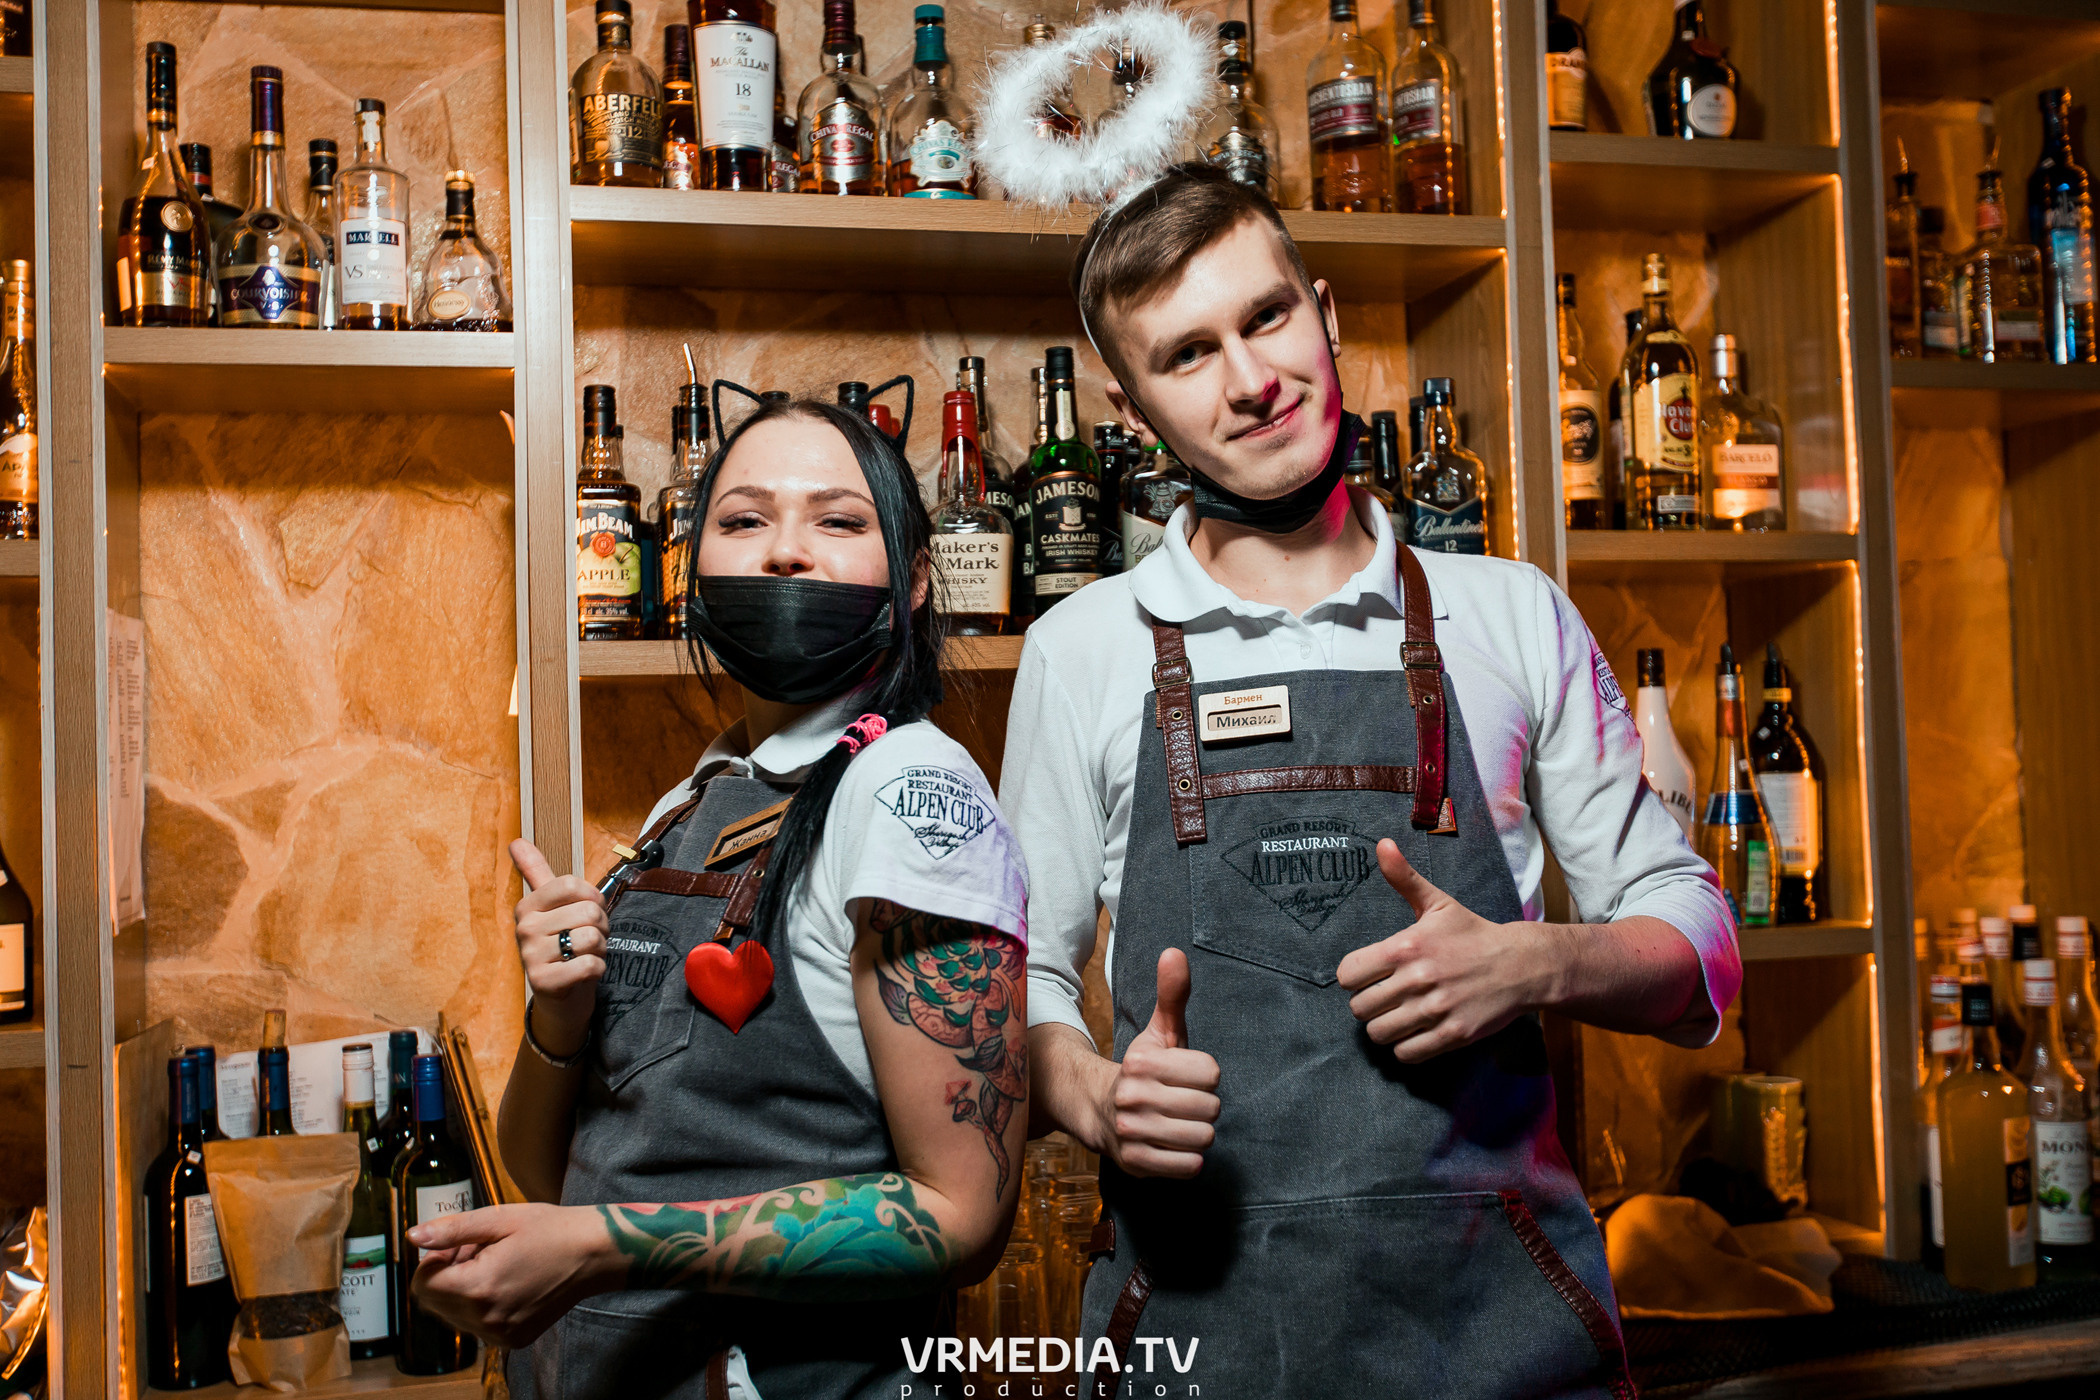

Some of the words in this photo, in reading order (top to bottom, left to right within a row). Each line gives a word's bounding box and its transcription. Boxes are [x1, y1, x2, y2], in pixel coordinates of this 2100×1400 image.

[736, 83, 751, 96] 18
[627, 126, 643, 138] 12
[810, 125, 843, 142] CHIVA
[846, 125, 875, 142] REGAL
[347, 232, 398, 244] MARELL
[345, 264, 363, 278] VS
[1036, 480, 1101, 505] JAMESON
[597, 511, 634, 540] BEAM
[1040, 532, 1100, 544] CASKMATES
[1045, 549, 1066, 557] IRISH
[1445, 540, 1459, 552] 12
[945, 556, 999, 570] Mark
[577, 569, 631, 581] APPLE
[1224, 694, 1263, 706] Бармен
[1216, 713, 1277, 729] Михаил
[907, 769, 941, 779] GRAND
[943, 772, 974, 792] RESORT
[907, 779, 973, 803] RESTAURANT
[892, 785, 950, 822] ALPEN
[950, 798, 984, 834] CLUB
[1260, 821, 1301, 839] GRAND
[1303, 820, 1349, 835] RESORT
[1261, 836, 1349, 853] RESTAURANT
[1249, 850, 1314, 886] ALPEN
[1317, 845, 1370, 883] CLUB
